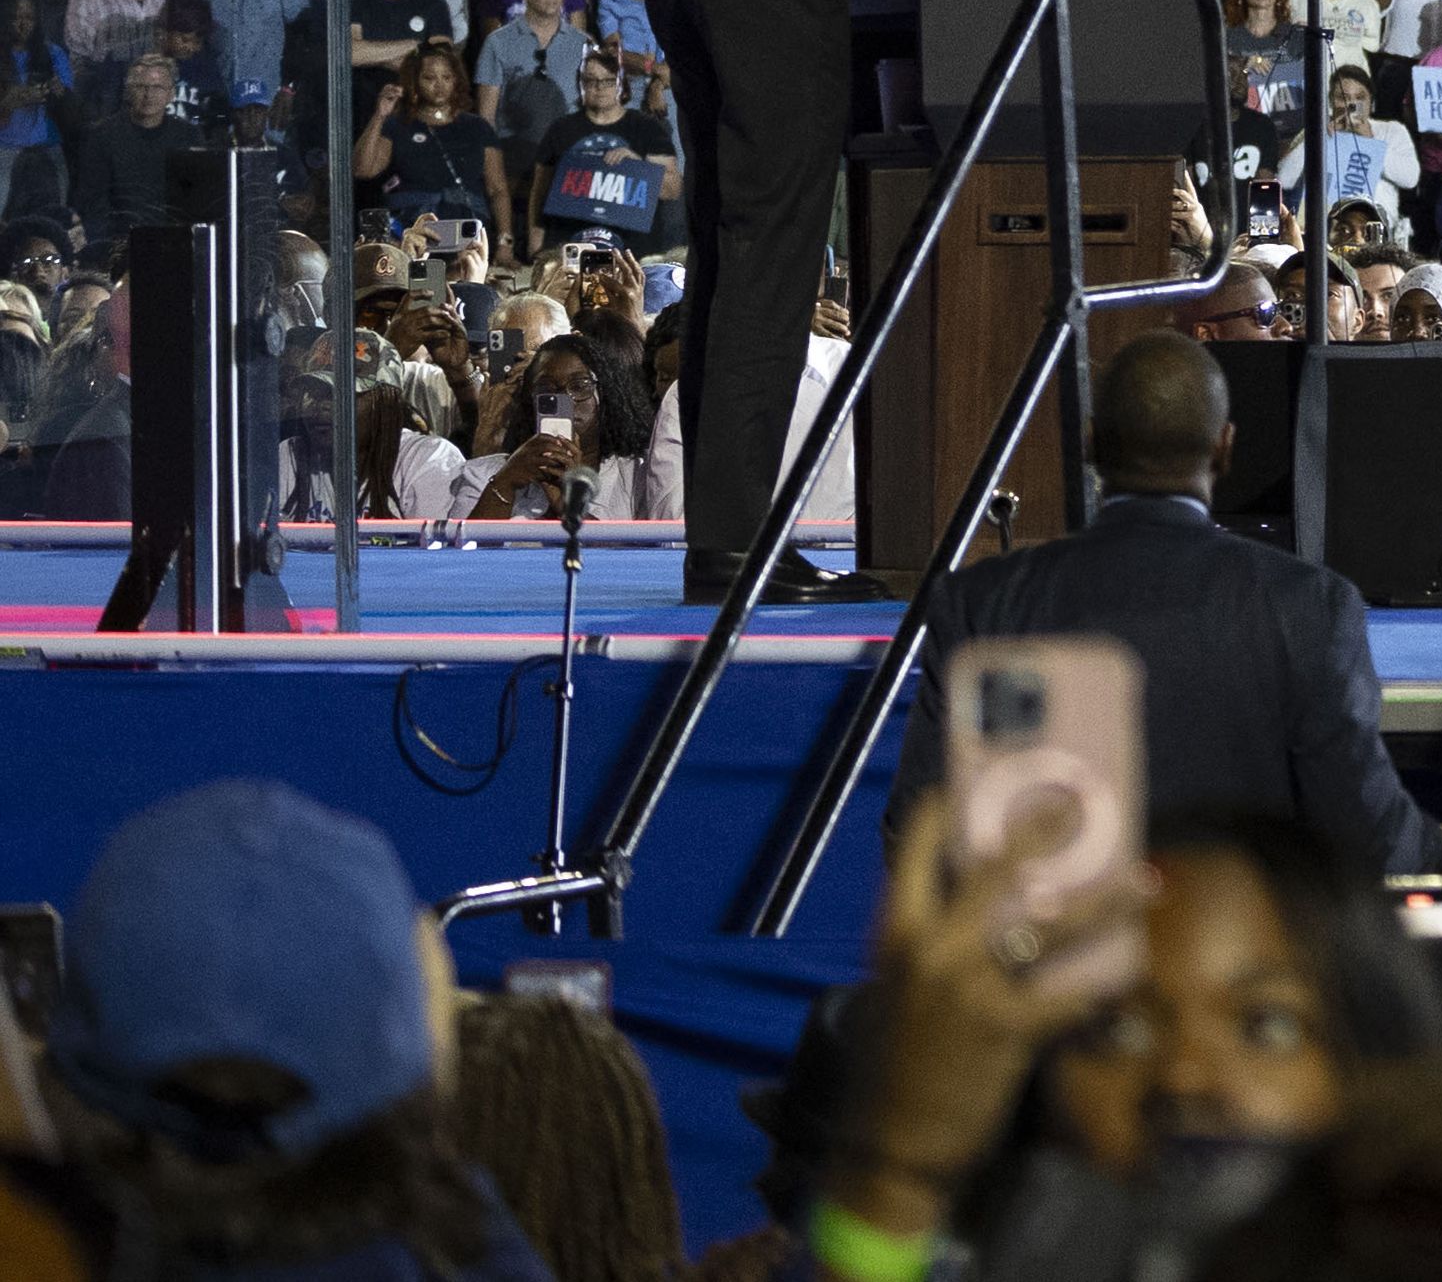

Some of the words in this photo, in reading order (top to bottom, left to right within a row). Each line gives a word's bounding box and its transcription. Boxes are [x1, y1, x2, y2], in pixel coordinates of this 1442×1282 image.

[1424, 82, 1435, 96] A
[559, 169, 650, 210] KAMALA
[1342, 151, 1372, 199] GEOR
